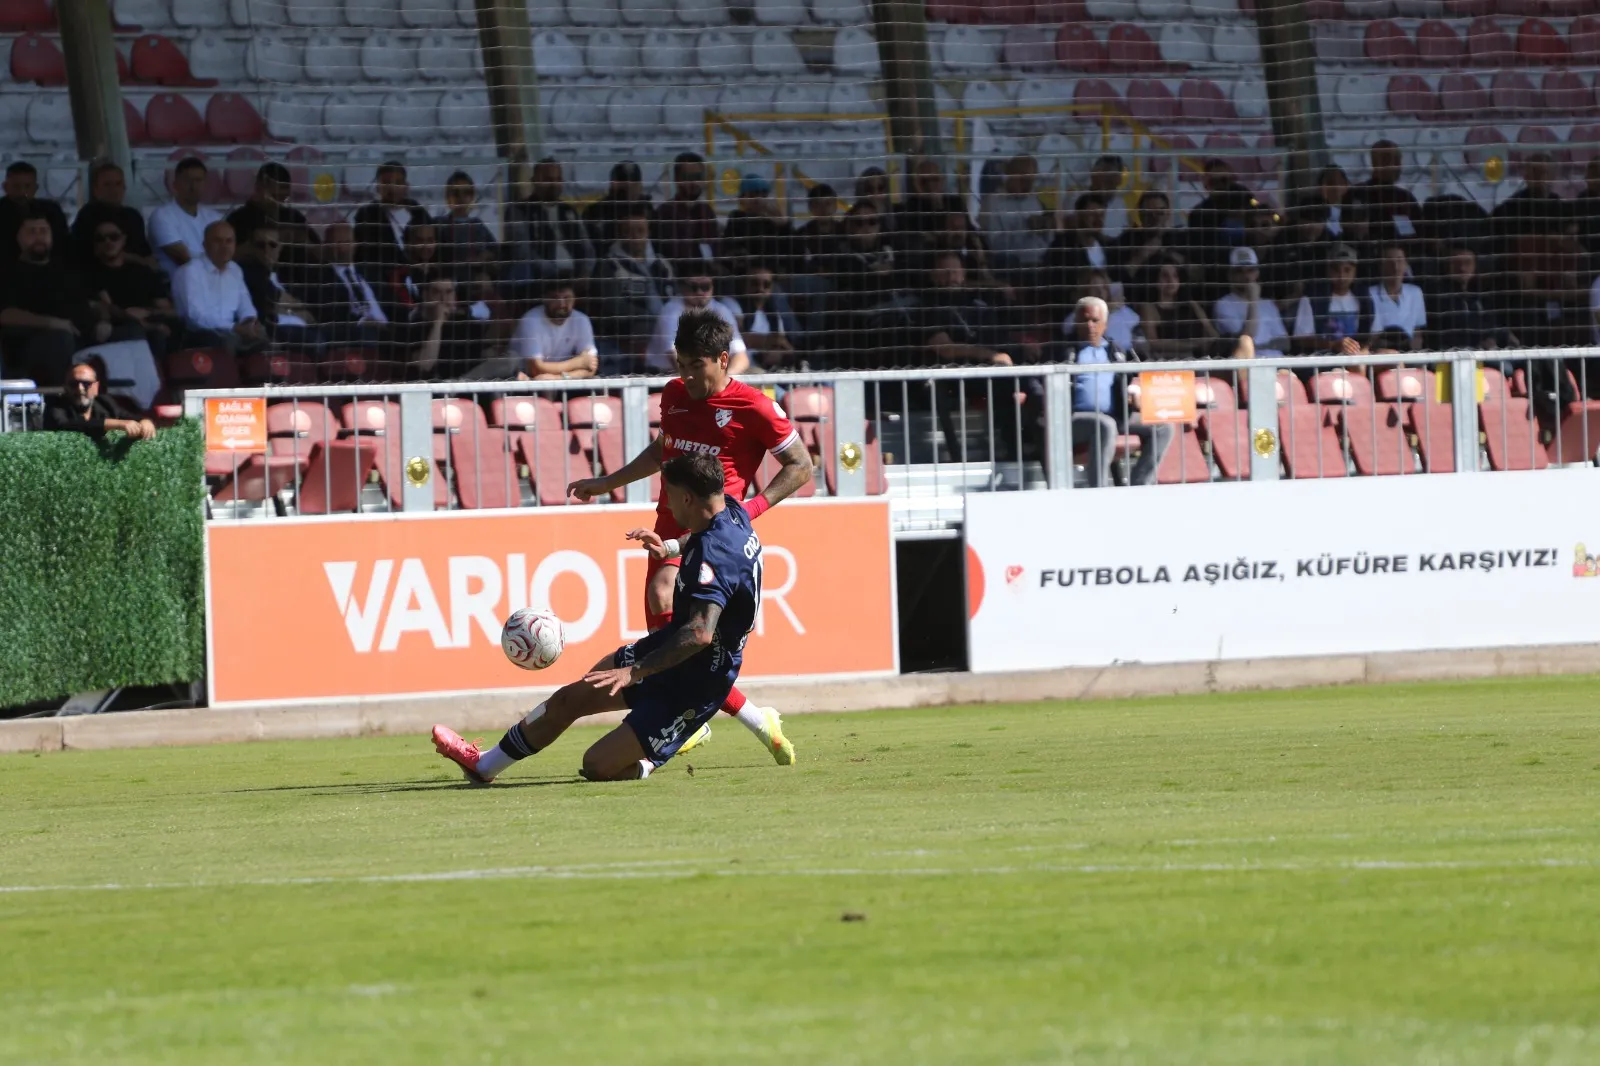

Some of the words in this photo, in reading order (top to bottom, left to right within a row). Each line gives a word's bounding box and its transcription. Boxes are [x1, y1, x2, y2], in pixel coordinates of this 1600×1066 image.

[673, 438, 721, 456] METRO
[1039, 565, 1172, 588] FUTBOLA
[1182, 556, 1286, 587] AŞIĞIZ,
[1296, 551, 1409, 577] KÜFÜRE
[1419, 547, 1559, 573] KARŞIYIZ!
